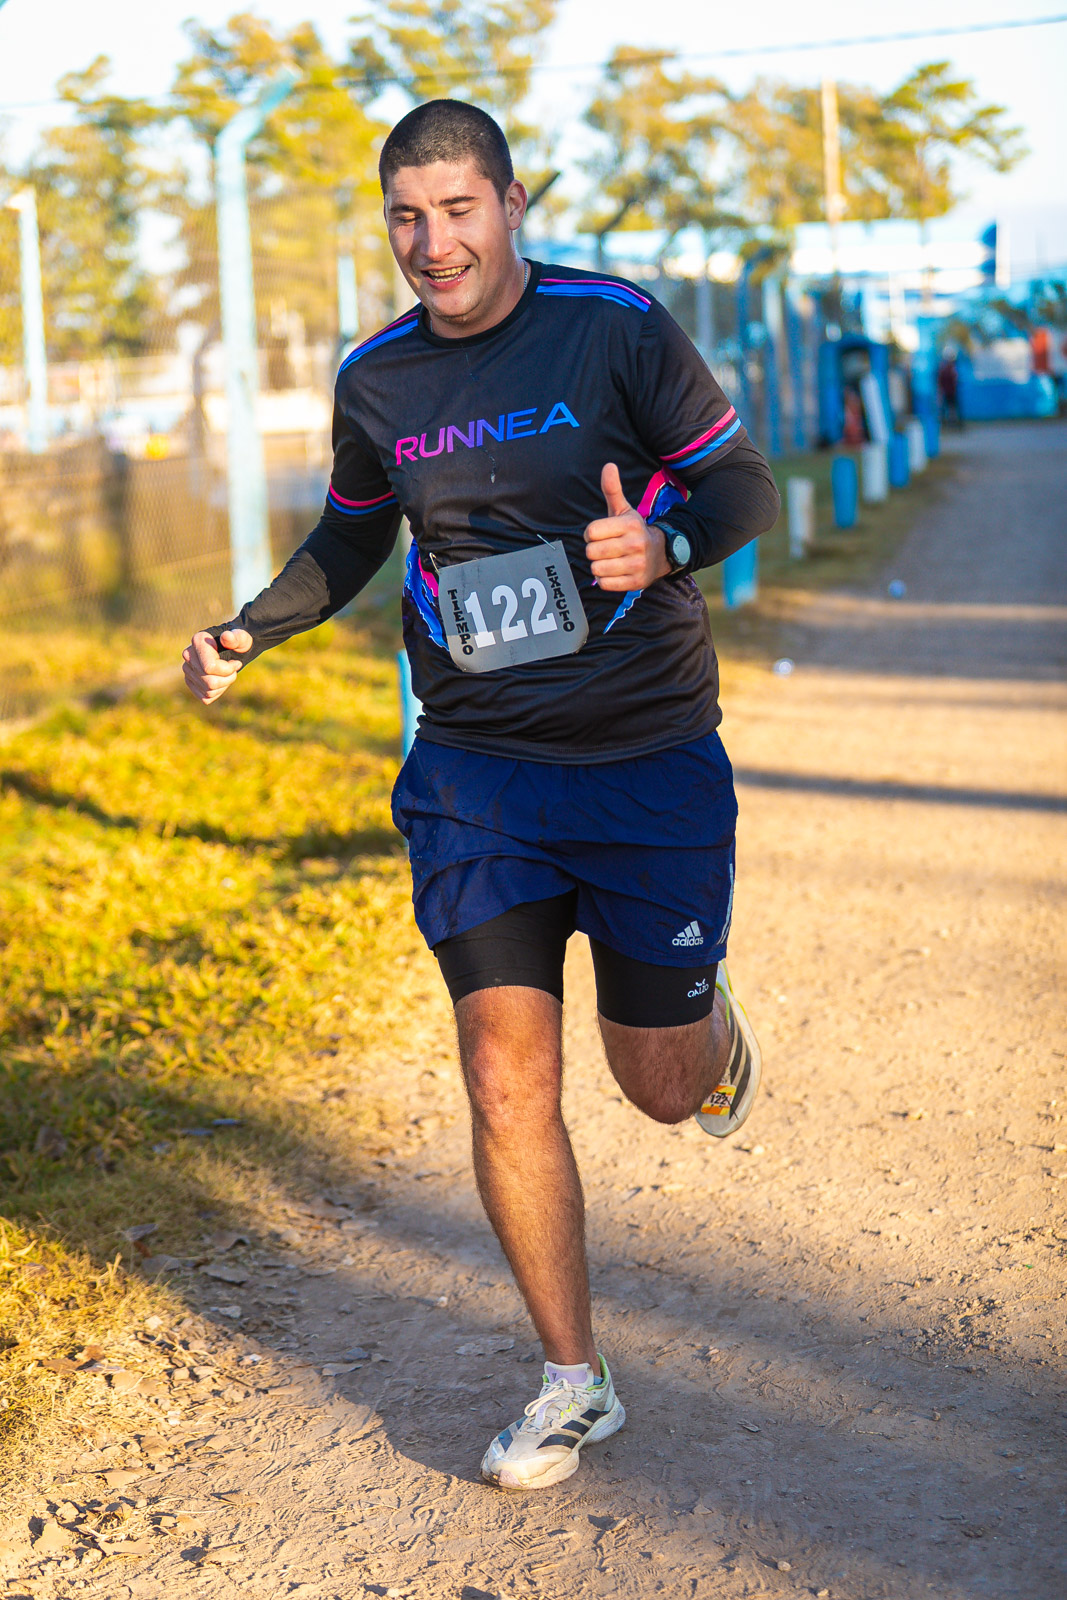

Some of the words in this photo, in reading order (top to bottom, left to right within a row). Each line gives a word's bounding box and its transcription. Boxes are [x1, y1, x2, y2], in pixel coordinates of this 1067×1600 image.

[395, 402, 580, 466] RUNNEA
[448, 589, 474, 655] TIEMPO
[464, 578, 558, 649] 122
[545, 565, 575, 632] EXACTO
[671, 936, 704, 947] adidas
[710, 1094, 728, 1106] 122
